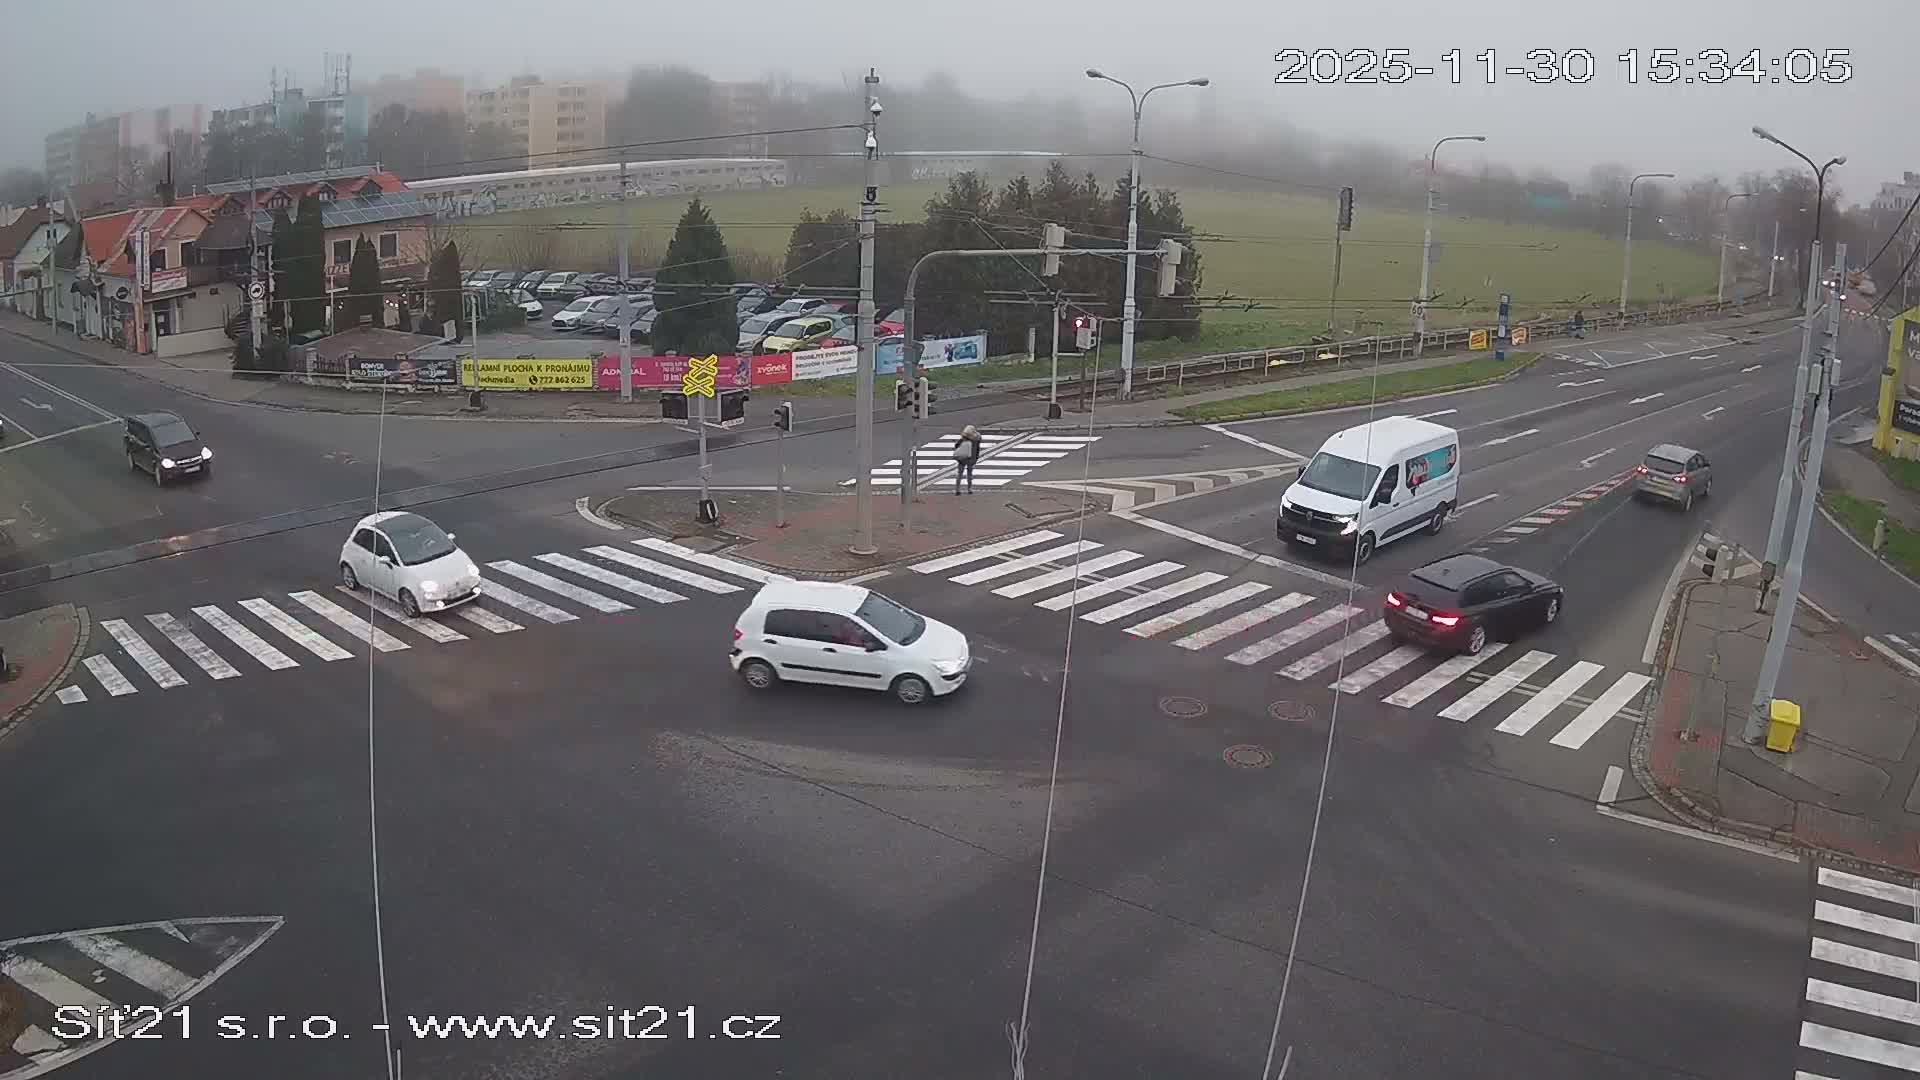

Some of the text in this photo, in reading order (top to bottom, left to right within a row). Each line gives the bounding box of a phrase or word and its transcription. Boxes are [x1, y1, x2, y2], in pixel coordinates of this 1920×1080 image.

[503, 364, 534, 373] PLOCHA
[536, 364, 543, 372] K
[545, 363, 590, 373] PRONÁJMU
